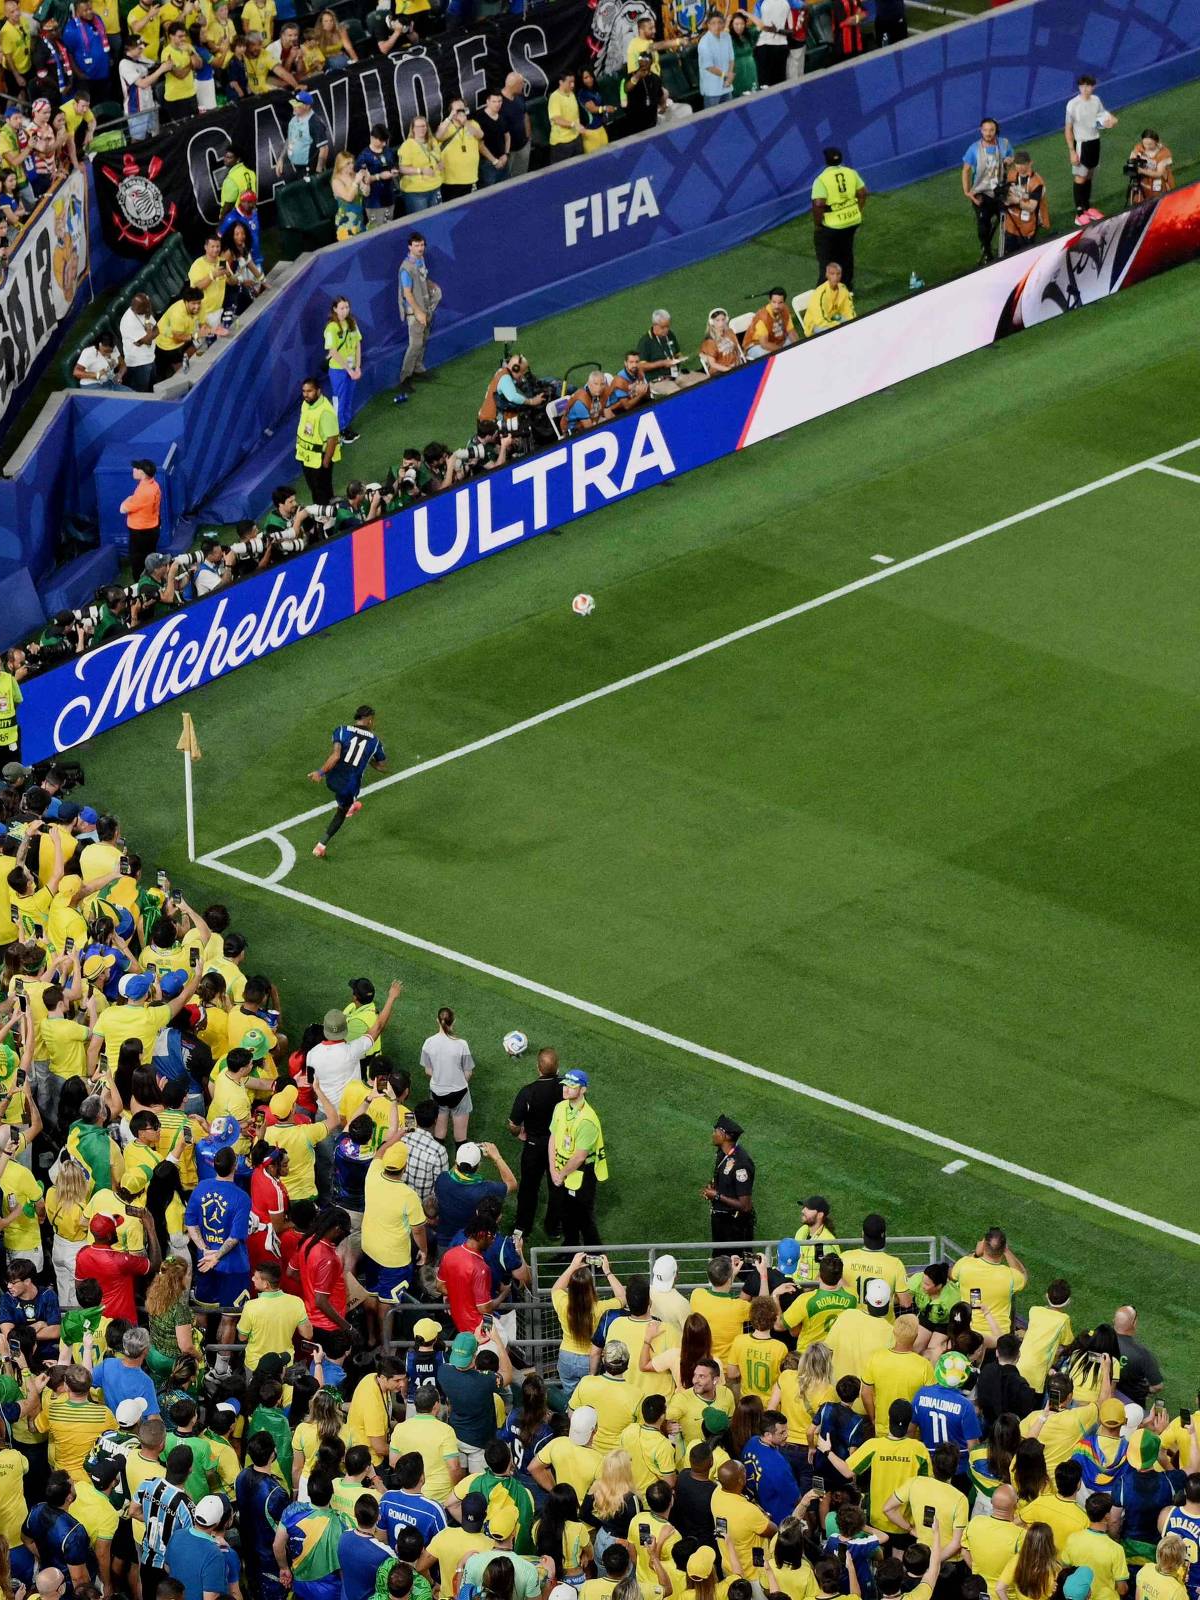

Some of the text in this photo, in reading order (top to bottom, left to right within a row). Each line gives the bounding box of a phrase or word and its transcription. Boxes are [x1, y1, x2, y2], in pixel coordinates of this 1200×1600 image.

[563, 176, 660, 248] FIFA
[413, 410, 676, 575] ULTRA
[53, 551, 329, 753] Michelob
[343, 736, 367, 767] 11
[815, 1295, 851, 1310] RONALDO
[746, 1347, 771, 1362] PELE
[415, 1364, 434, 1373] PAULO
[745, 1359, 771, 1393] 10
[918, 1395, 962, 1415] RONALDINHO
[929, 1410, 949, 1444] 11
[879, 1455, 911, 1463] BRASIL
[387, 1508, 417, 1526] RONALDO
